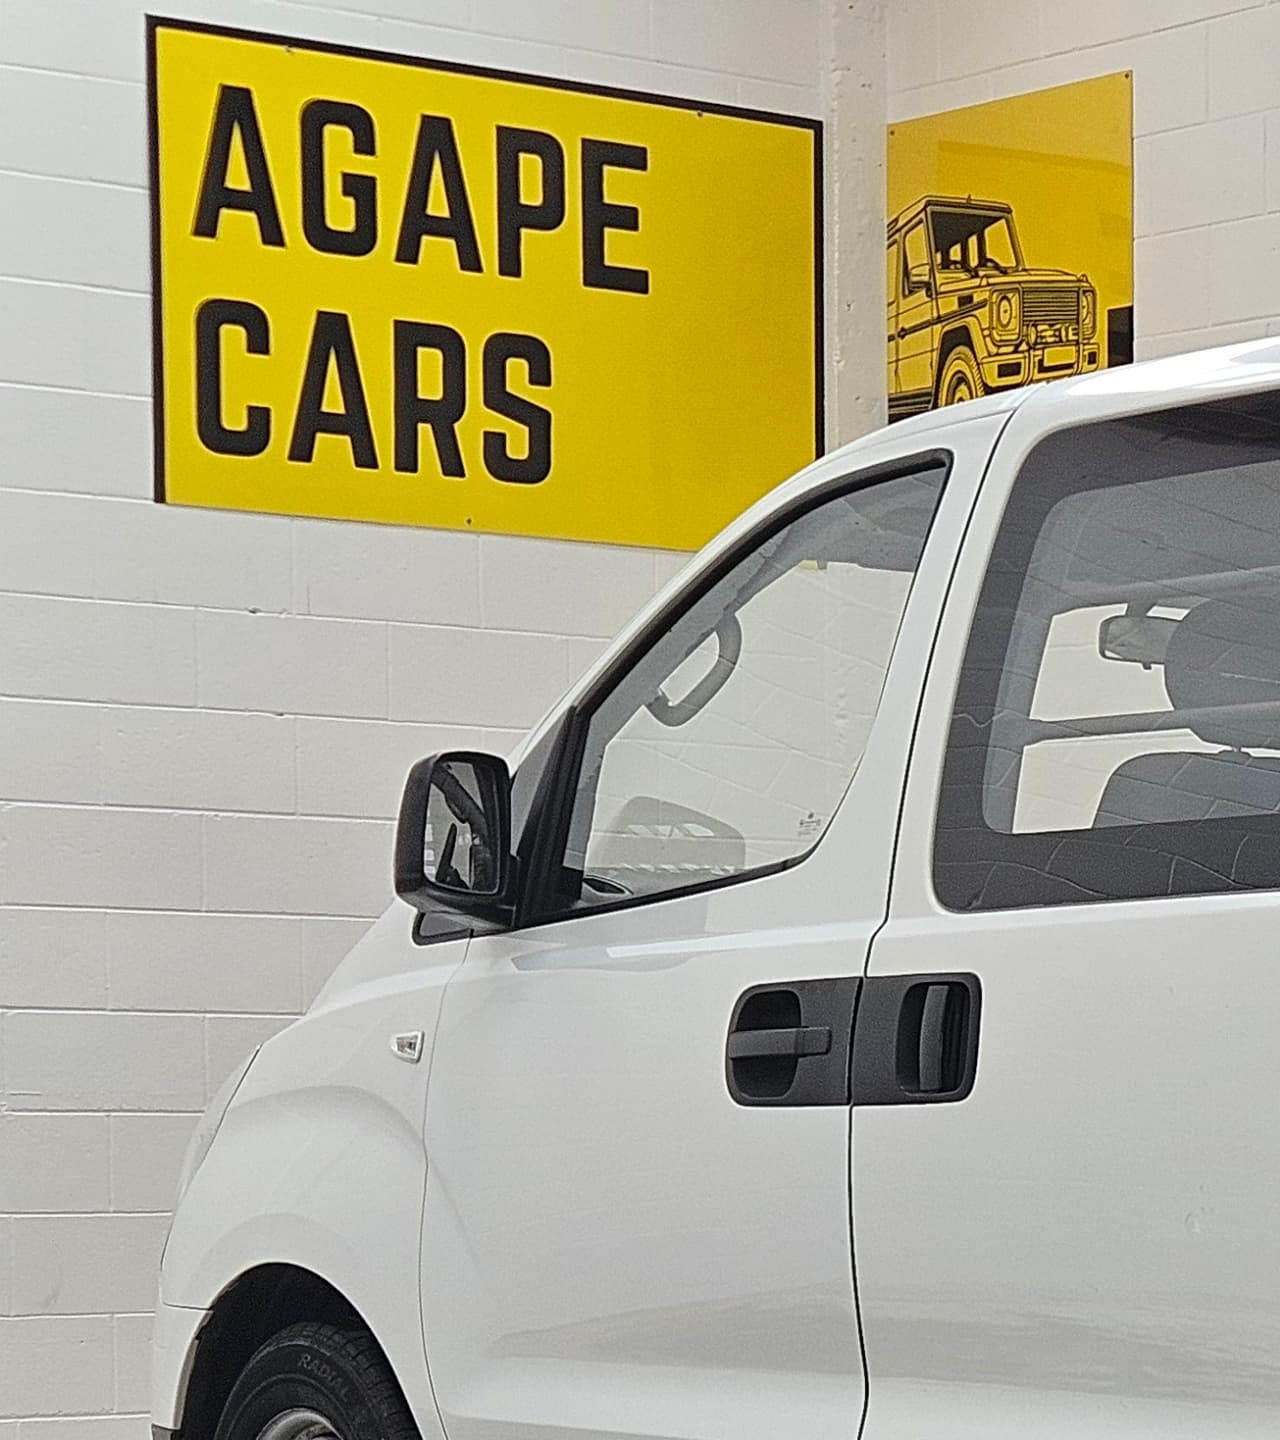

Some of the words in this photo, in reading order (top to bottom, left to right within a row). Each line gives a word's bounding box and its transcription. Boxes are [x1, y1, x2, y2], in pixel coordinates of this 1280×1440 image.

[191, 84, 649, 295] AGAPE
[194, 298, 552, 485] CARS
[300, 1353, 349, 1402] RADIAL
